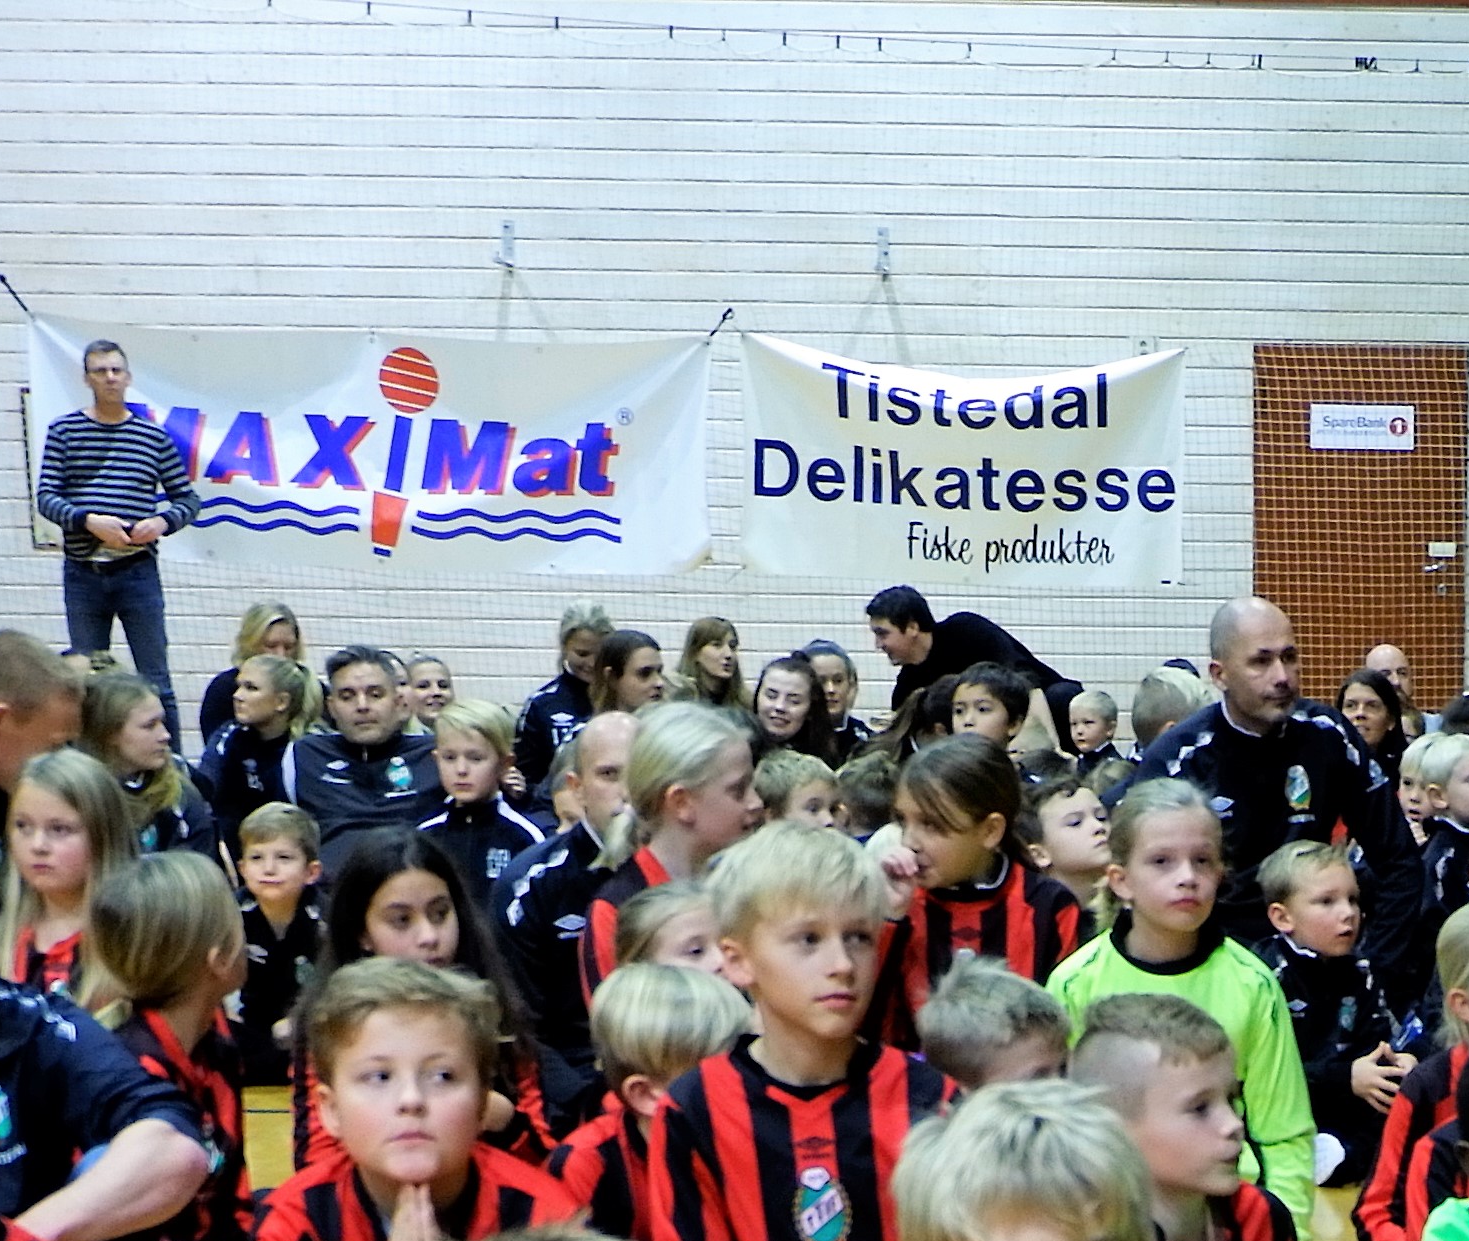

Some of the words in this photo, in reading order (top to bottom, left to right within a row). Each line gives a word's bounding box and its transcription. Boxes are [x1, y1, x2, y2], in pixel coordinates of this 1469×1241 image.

[821, 362, 1108, 430] Tistedal
[753, 438, 1177, 514] Delikatesse
[906, 521, 974, 566] Fiske
[984, 523, 1116, 573] produkter
